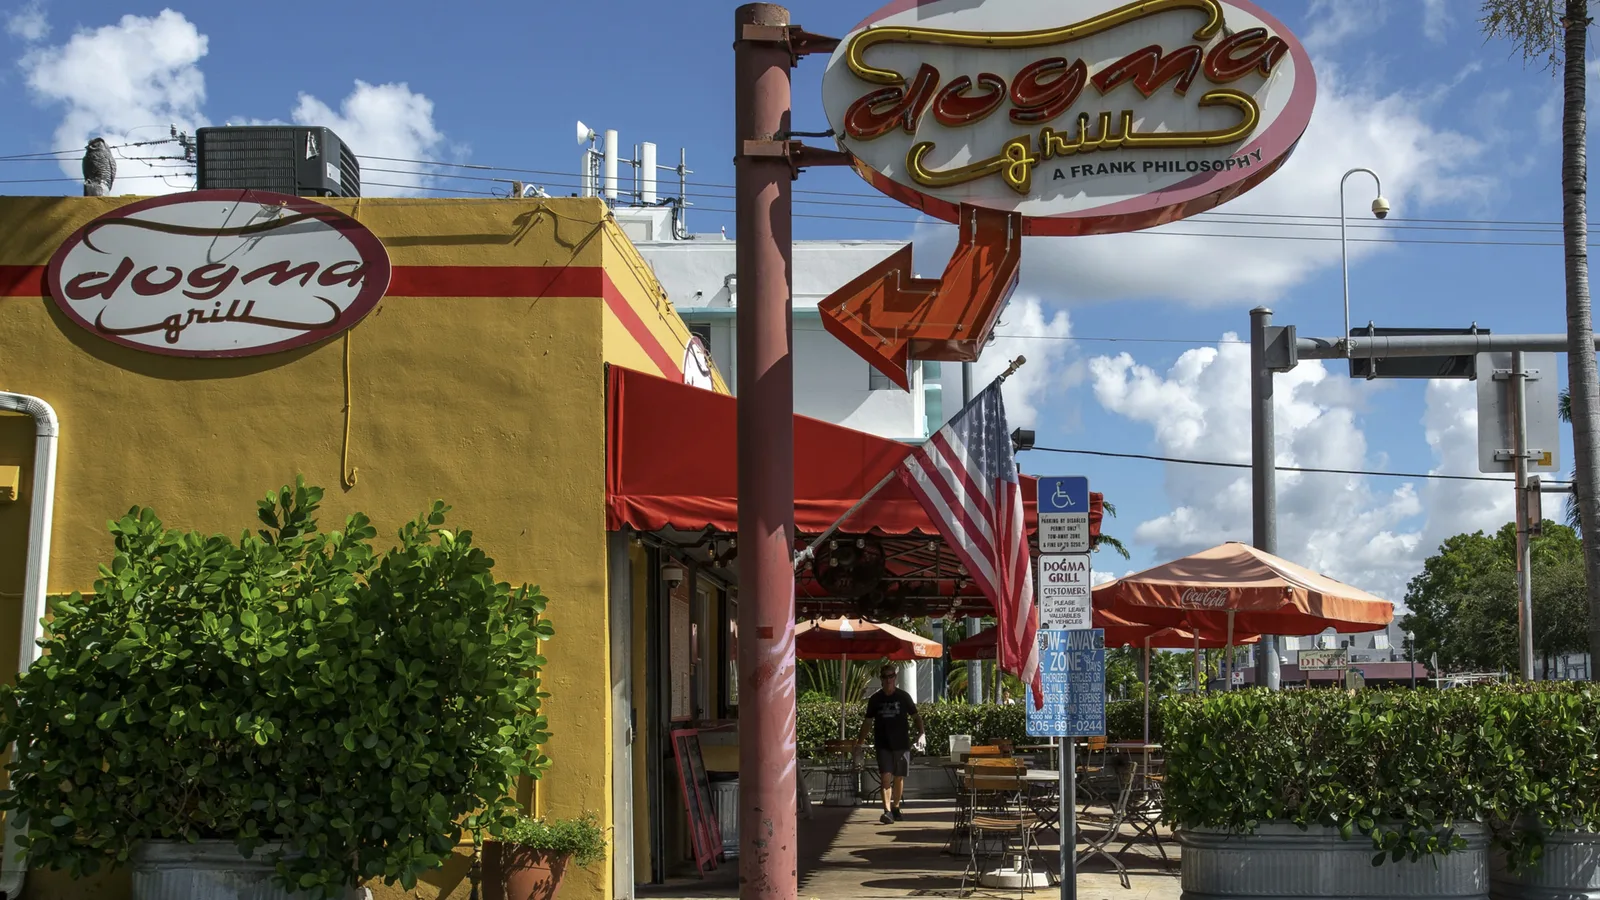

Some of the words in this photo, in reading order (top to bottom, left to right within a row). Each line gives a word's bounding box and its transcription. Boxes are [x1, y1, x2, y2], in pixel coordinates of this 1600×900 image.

[844, 27, 1289, 140] dogma
[1001, 110, 1135, 195] grill
[1052, 168, 1066, 181] A
[1070, 160, 1137, 179] FRANK
[1142, 148, 1263, 174] PHILOSOPHY
[64, 256, 372, 300] dogma
[162, 300, 256, 344] grill
[1044, 561, 1086, 572] DOGMA
[1048, 573, 1080, 583] GRILL
[1043, 587, 1087, 595] CUSTOMERS
[1050, 651, 1082, 672] ZONE
[1300, 658, 1346, 666] DINER
[1079, 693, 1101, 704] EXPENSE
[1078, 704, 1103, 714] STORAGE
[1028, 720, 1103, 732] 305-691-0244
